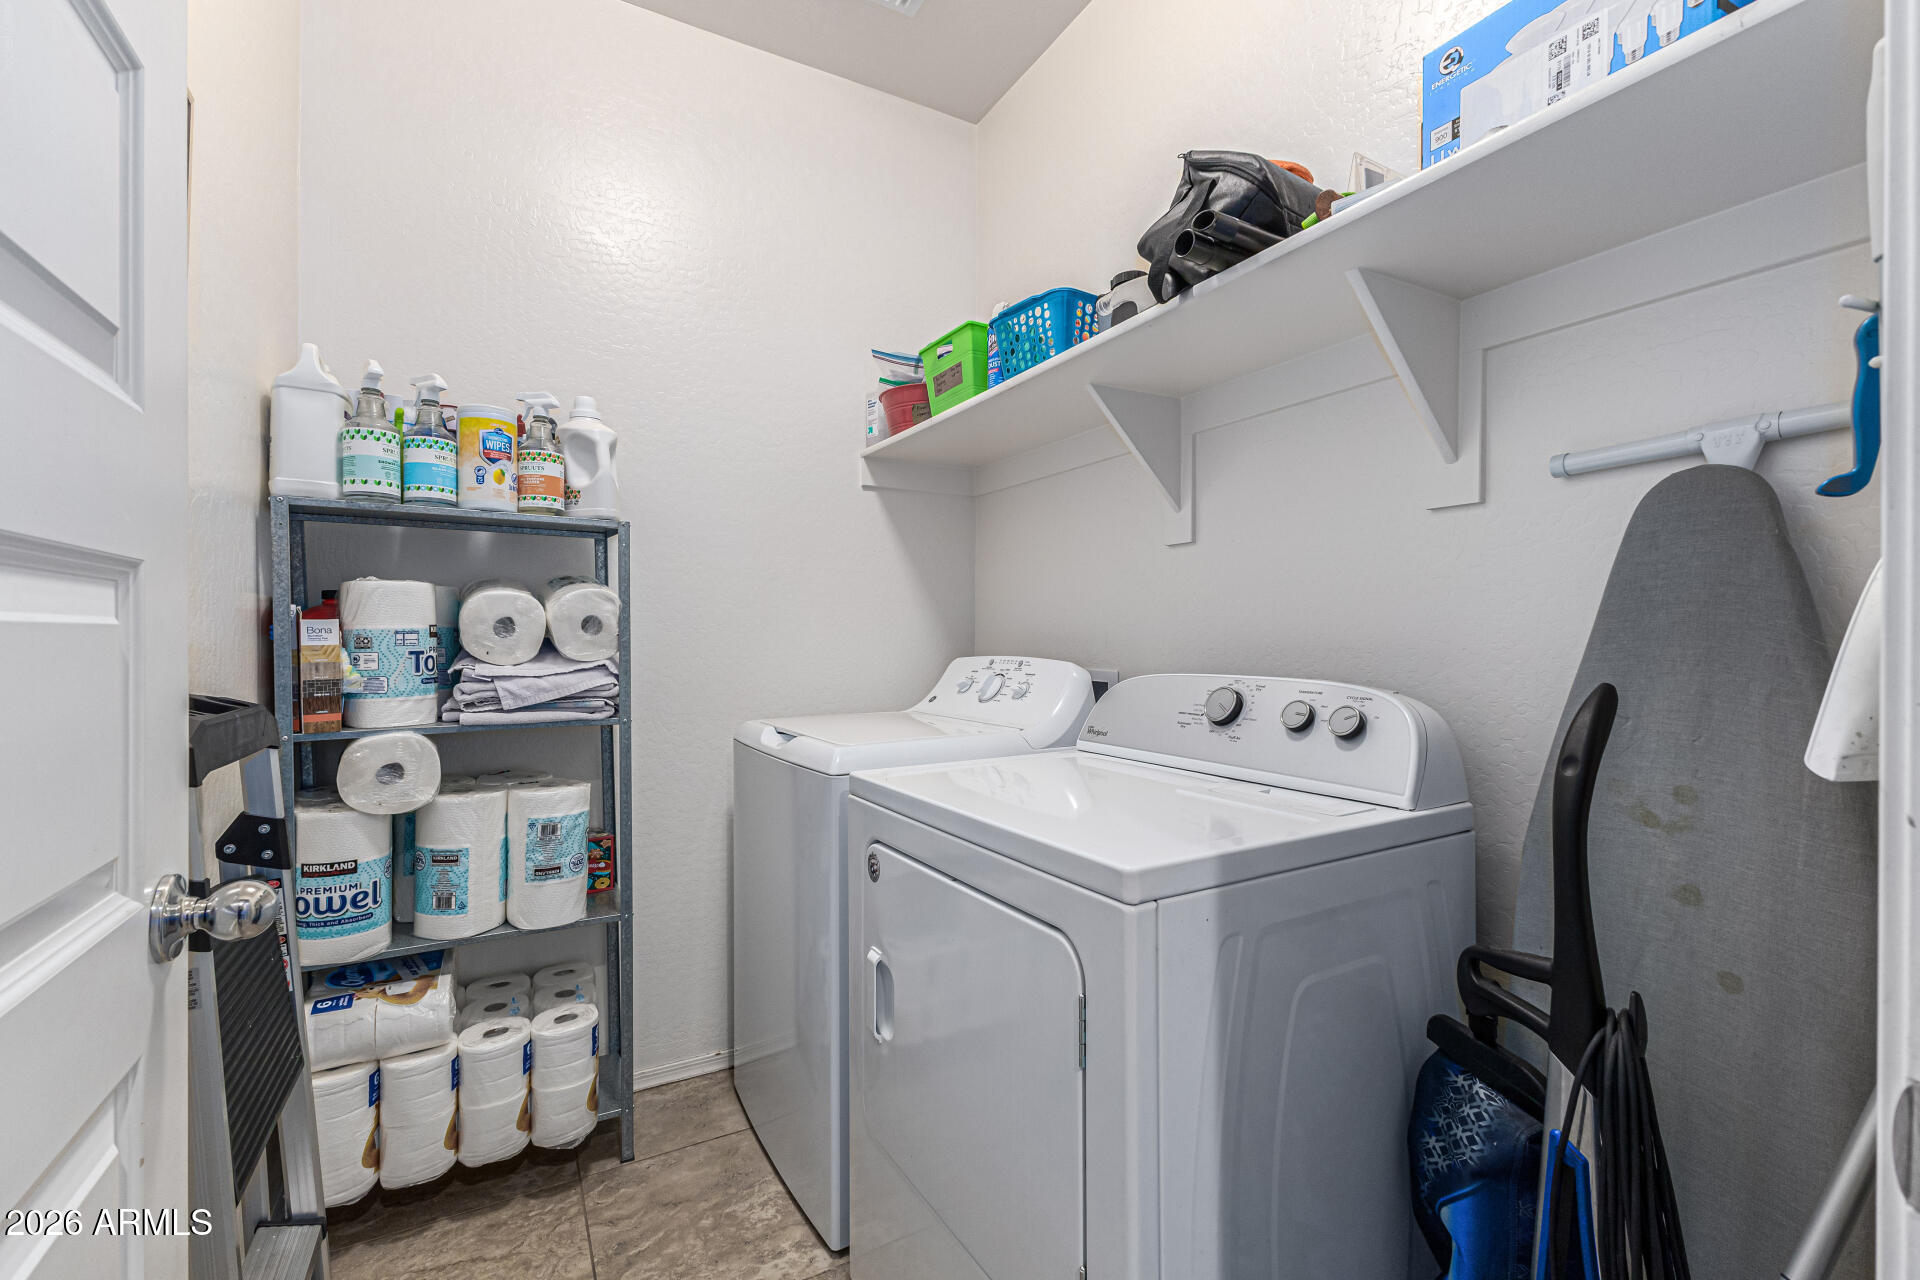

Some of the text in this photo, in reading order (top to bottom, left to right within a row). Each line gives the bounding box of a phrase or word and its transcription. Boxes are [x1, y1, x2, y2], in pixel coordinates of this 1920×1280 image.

[1431, 62, 1472, 90] ENERGETIC
[485, 439, 510, 453] WIPES
[306, 625, 333, 635] Bona
[407, 650, 436, 674] To
[302, 861, 356, 873] KIRKLAND
[299, 882, 359, 896] PREMIUM
[295, 880, 380, 917] owel
[340, 913, 373, 924] Absorbent
